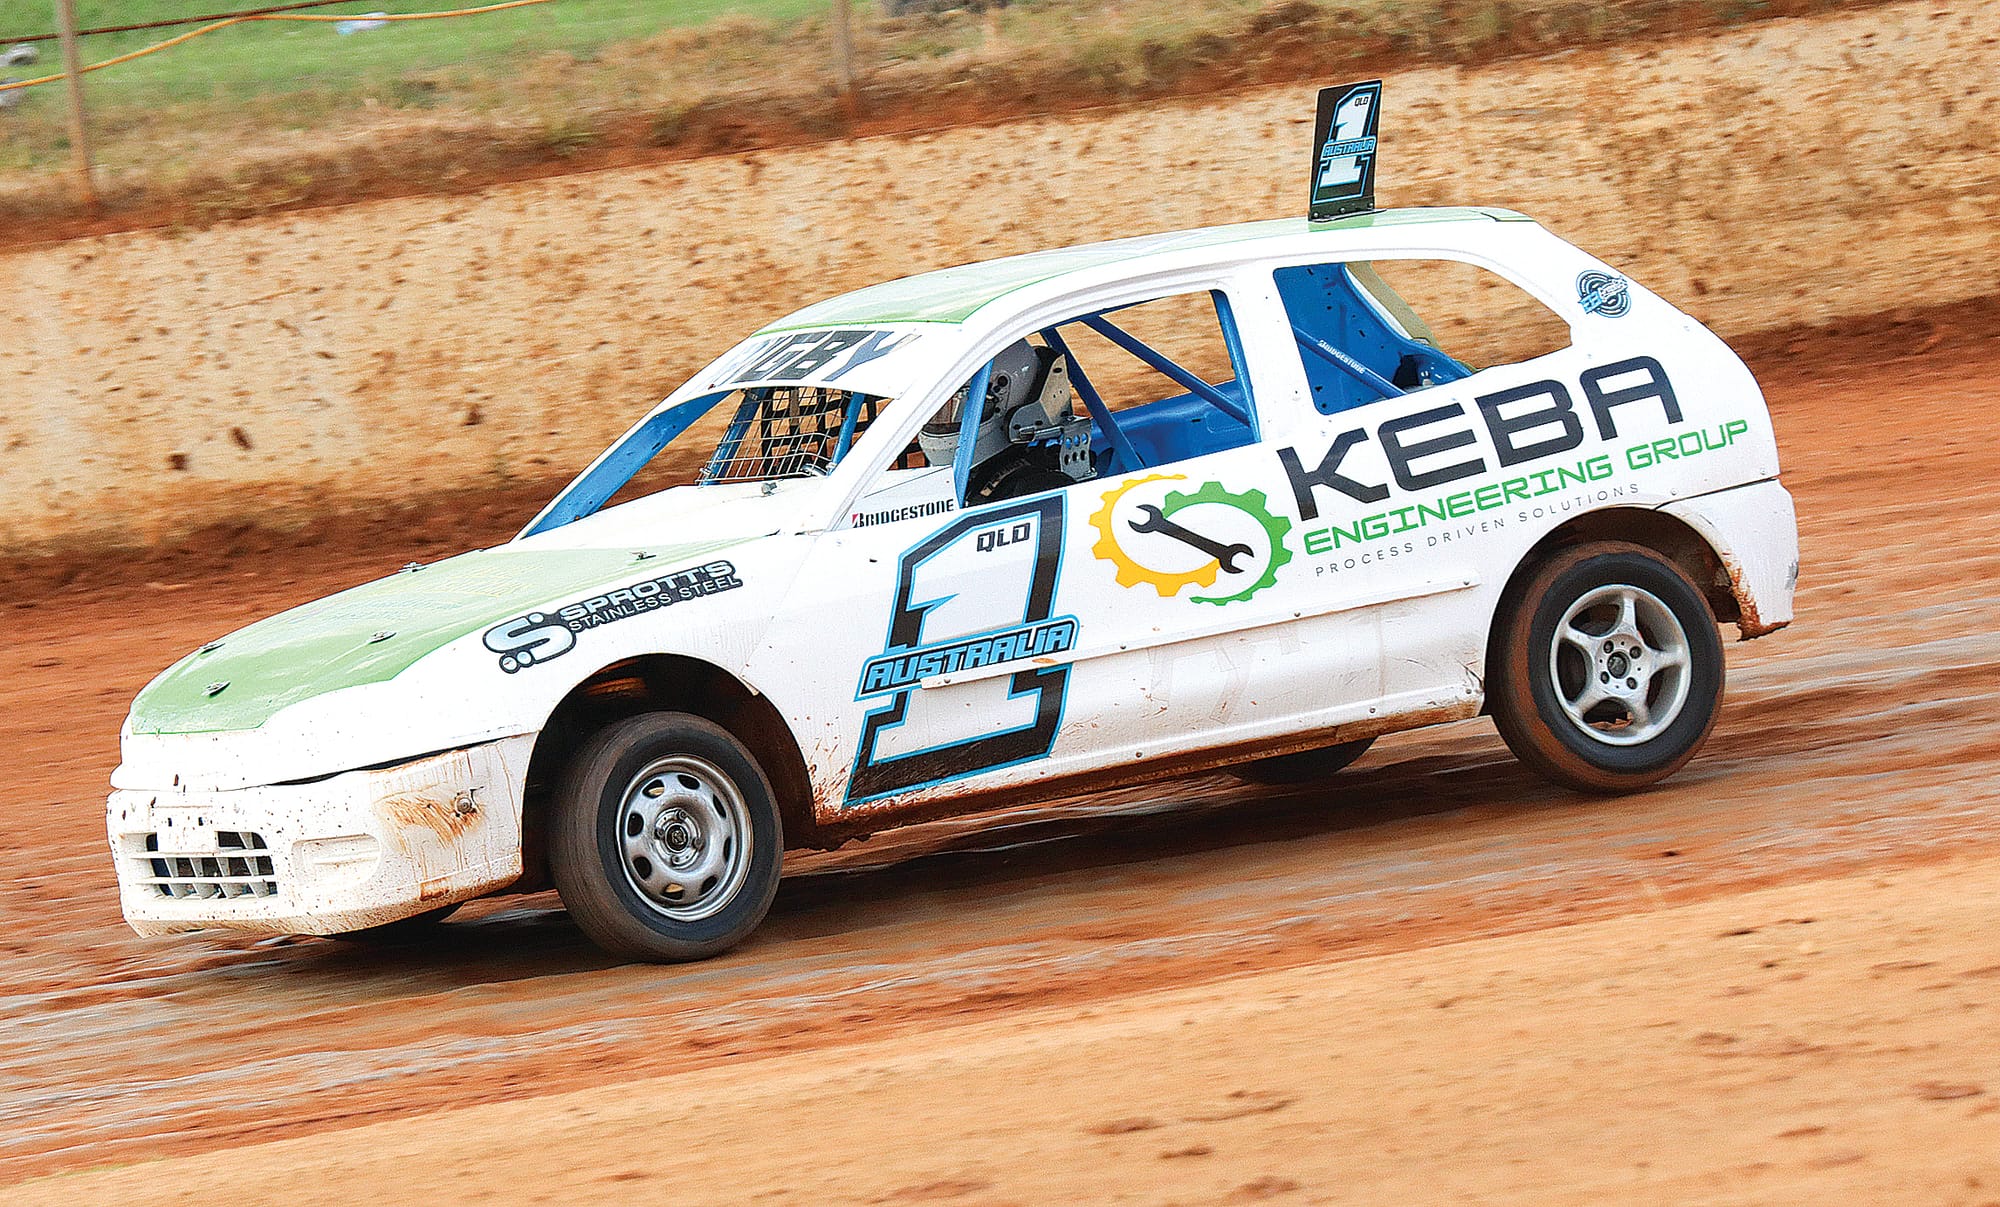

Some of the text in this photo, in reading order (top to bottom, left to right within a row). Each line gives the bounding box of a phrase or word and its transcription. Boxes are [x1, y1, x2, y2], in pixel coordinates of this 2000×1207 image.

[1354, 96, 1369, 107] QLD
[1316, 87, 1377, 197] 1
[1323, 138, 1375, 158] AUSTRALIA
[1276, 355, 1684, 522] KEBA
[852, 498, 954, 529] BRIDGESTONE
[1303, 419, 1748, 556] ENGINEERING GROUP
[977, 522, 1031, 552] QLD
[1315, 483, 1640, 577] PROCESS DRIVEN SOLUTIONS
[560, 561, 735, 622] SPROTT'S
[569, 576, 741, 631] STAINLESS STEEL
[850, 494, 1060, 797] 1
[863, 622, 1071, 691] AUSTRALIA
